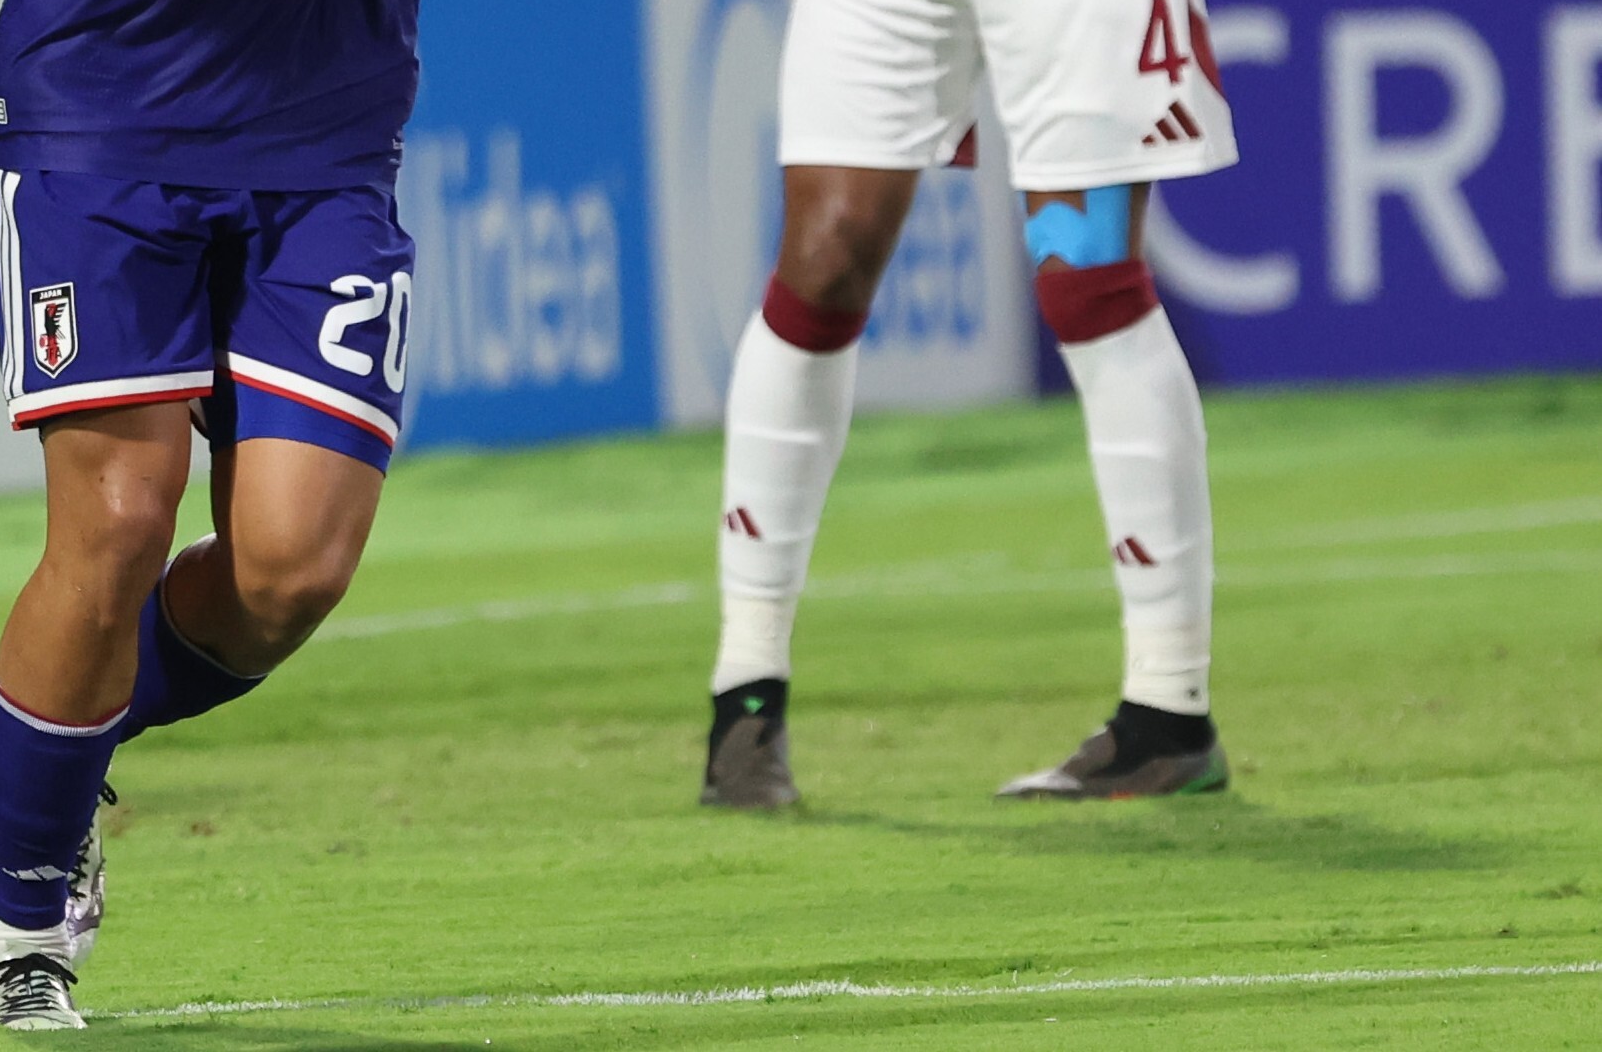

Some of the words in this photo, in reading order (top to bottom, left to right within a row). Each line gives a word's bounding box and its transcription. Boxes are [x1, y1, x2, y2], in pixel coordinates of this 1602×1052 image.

[39, 289, 63, 300] JAPAN
[401, 130, 620, 388] idea
[318, 271, 412, 394] 20
